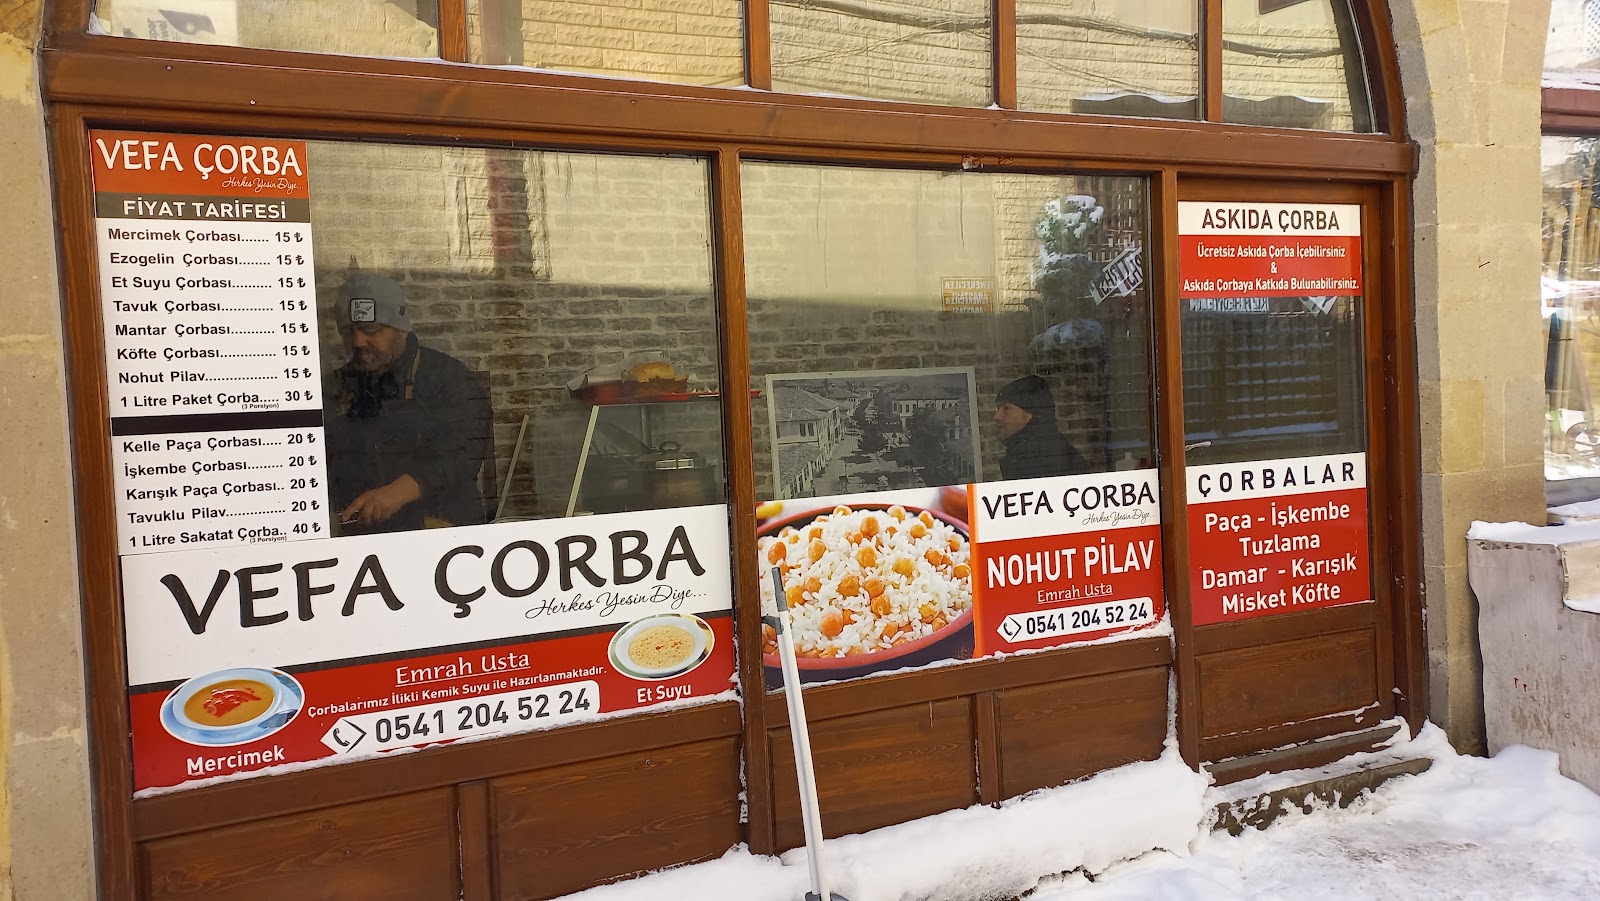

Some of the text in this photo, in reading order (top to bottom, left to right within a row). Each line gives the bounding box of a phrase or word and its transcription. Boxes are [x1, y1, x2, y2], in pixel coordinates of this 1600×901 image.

[96, 138, 302, 180] VEFA ÇORBA
[222, 176, 252, 188] Herkes
[253, 178, 276, 192] Yesin
[123, 196, 286, 219] FİYAT TARİFESİ
[1202, 208, 1340, 232] ASKIDA ÇORBA
[108, 228, 180, 241] Mercimek
[275, 232, 290, 242] 15
[110, 252, 174, 266] Ezogelin
[276, 254, 292, 265] 15
[1197, 242, 1346, 259] Ücretsiz Askıda Çorba İçebilirsiniz
[1270, 262, 1278, 274] &
[112, 277, 127, 288] Et
[132, 277, 170, 290] Suyu
[278, 277, 294, 288] 15
[1183, 278, 1360, 293] Askıda Çorbaya Katkıda Bulunabilirsiniz.
[113, 300, 158, 312] Tavuk
[279, 300, 295, 310] 15
[115, 325, 166, 336] Mantar
[280, 323, 296, 333] 15
[117, 348, 157, 360] Köfte
[282, 346, 298, 356] 15
[119, 372, 164, 383] Nohut
[283, 368, 299, 379] 15
[121, 397, 127, 407] 1
[134, 396, 167, 407] Litre
[172, 394, 212, 406] Paket
[285, 390, 300, 401] 30
[123, 440, 160, 452] Kelle
[166, 440, 201, 452] Paça
[287, 434, 302, 444] 20
[125, 462, 186, 479] İşkembe
[288, 456, 304, 467] 20
[126, 489, 178, 500] Karışık
[183, 486, 217, 498] Paça
[290, 478, 306, 490] 20
[1198, 462, 1354, 497] ÇORBALAR
[982, 481, 1156, 520] VEFA ÇORBA
[127, 510, 184, 524] Tavuklu
[292, 501, 307, 512] 20
[1082, 512, 1110, 525] Herkes
[1205, 513, 1251, 533] Paça
[1271, 501, 1350, 527] İşkembe
[130, 536, 136, 547] 1
[142, 534, 176, 547] Litre
[180, 529, 233, 542] Sakatat
[293, 523, 308, 534] 40
[1239, 534, 1320, 556] Tuzlama
[987, 537, 1154, 589] NOHUT PİLAV
[1202, 567, 1268, 589] Damar
[1291, 553, 1357, 578] Karışık
[160, 525, 706, 635] VEFA ÇORBA
[1037, 582, 1113, 602] Emrah Usta
[1222, 583, 1341, 614] Misket Köfte
[525, 594, 594, 619] Herkes
[596, 591, 648, 618] Yesin
[1026, 602, 1148, 635] 0541 204 52 24
[396, 652, 529, 684] Emrah Usta
[308, 666, 607, 718] Çorbalarımız İlikli Kemik Suyu ile Hazırlanmaktadır.
[637, 683, 692, 703] Et Suyu
[376, 688, 590, 743] 0541 204 52 24
[186, 745, 285, 776] Mercimek
